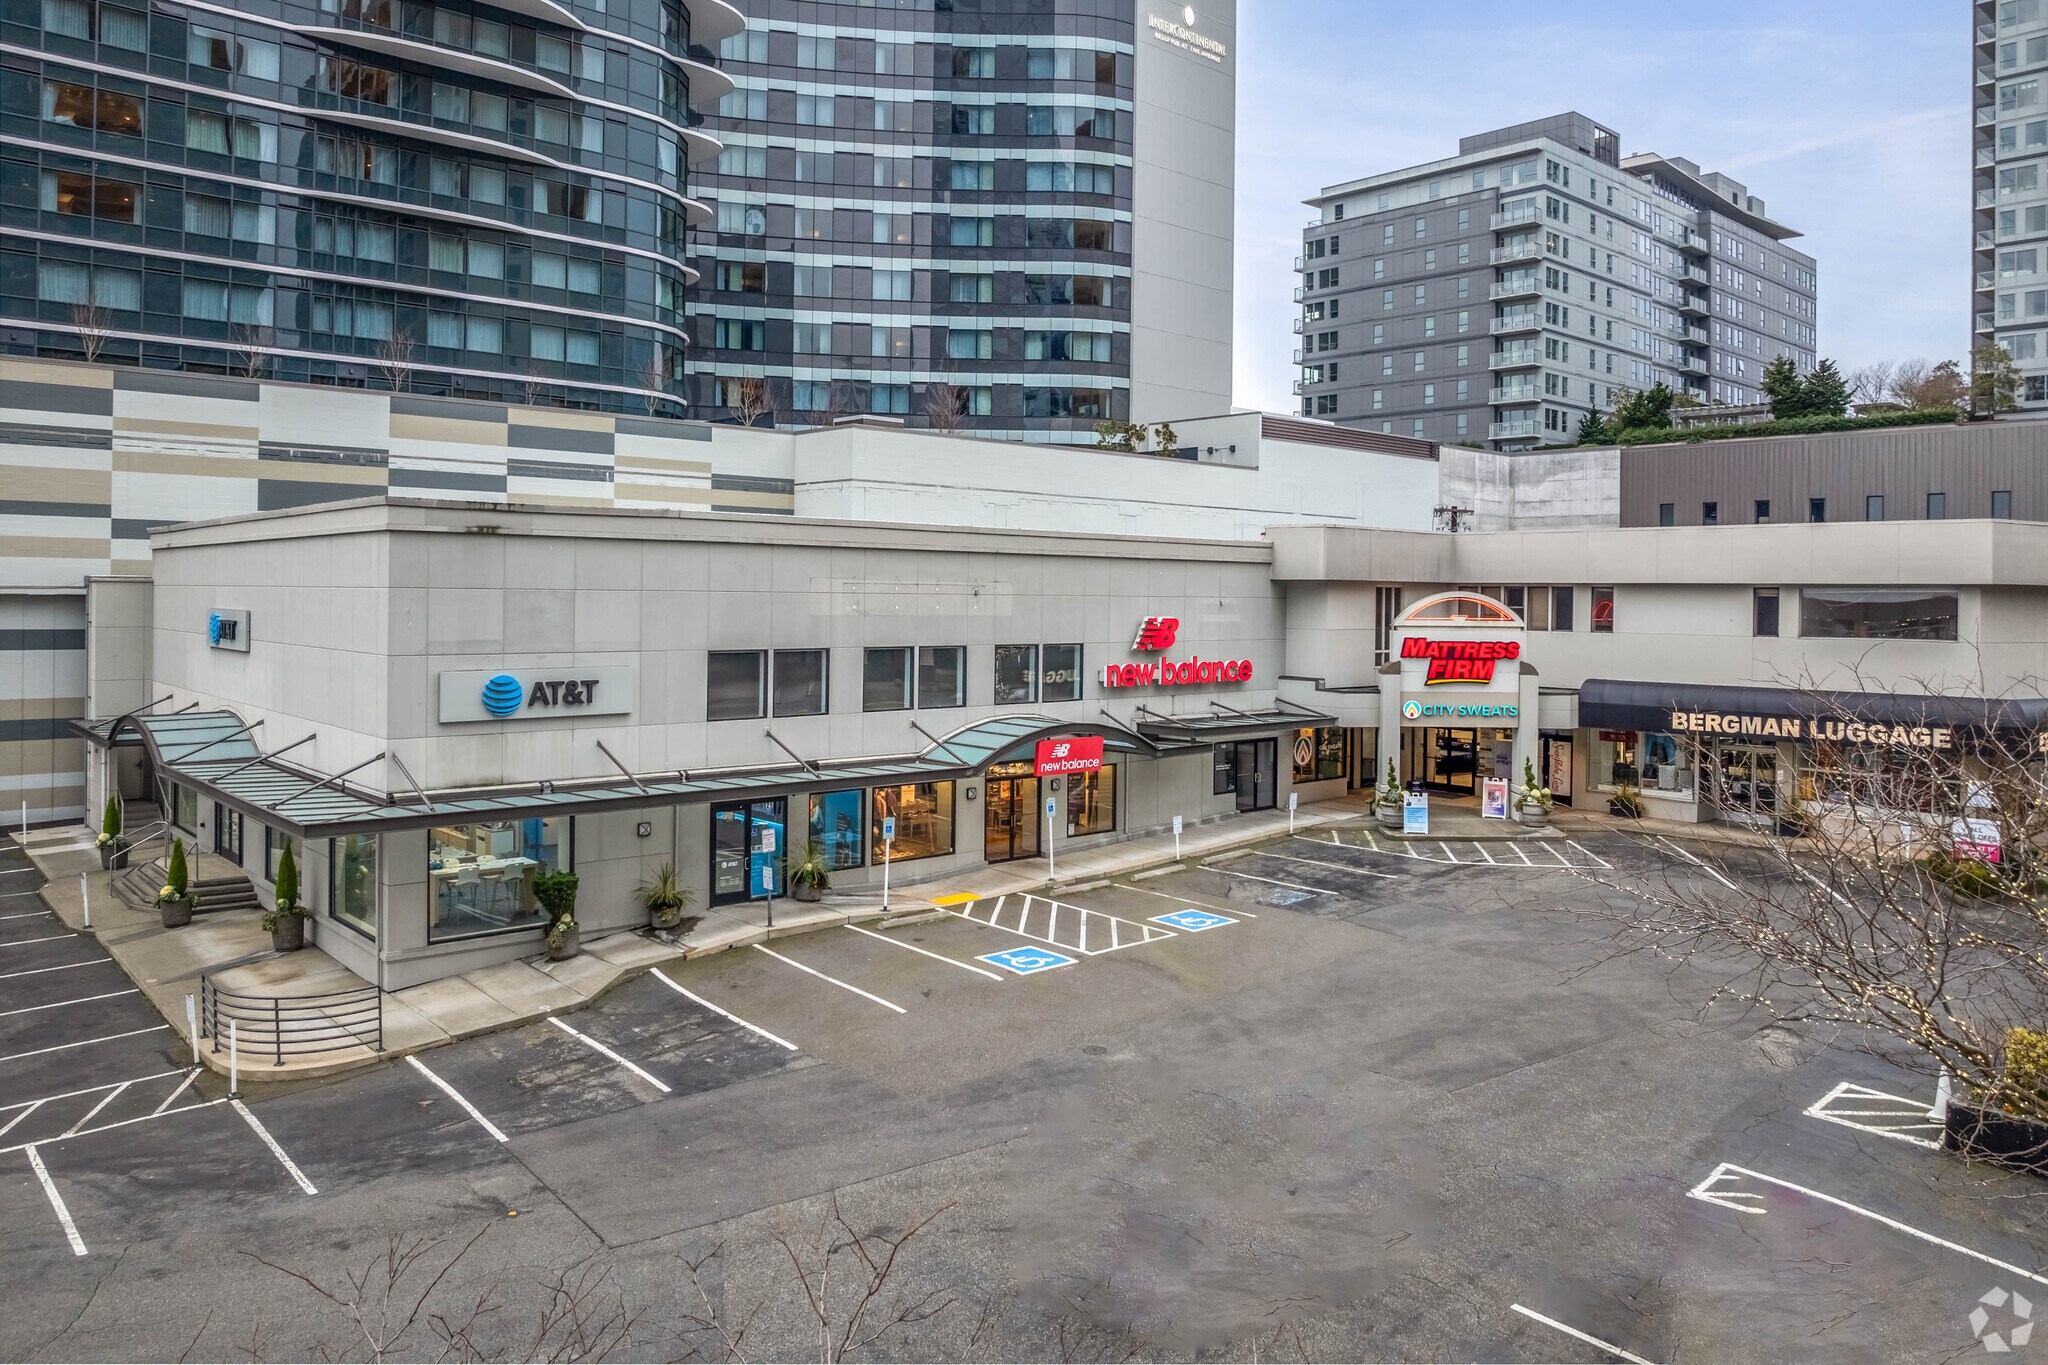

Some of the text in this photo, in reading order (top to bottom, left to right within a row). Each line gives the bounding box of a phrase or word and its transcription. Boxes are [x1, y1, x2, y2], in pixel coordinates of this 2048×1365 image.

[1190, 46, 1200, 55] THE
[1201, 51, 1221, 63] AVENUE
[1400, 637, 1520, 660] MATTRESS
[1104, 655, 1253, 688] new balance
[1426, 658, 1496, 681] FIRM
[527, 679, 600, 707] AT&T
[1422, 705, 1518, 717] CITY SWEATS
[1672, 711, 1953, 749] BERGMAN LUGGAGE
[1040, 761, 1062, 772] new
[1061, 757, 1100, 771] balance
